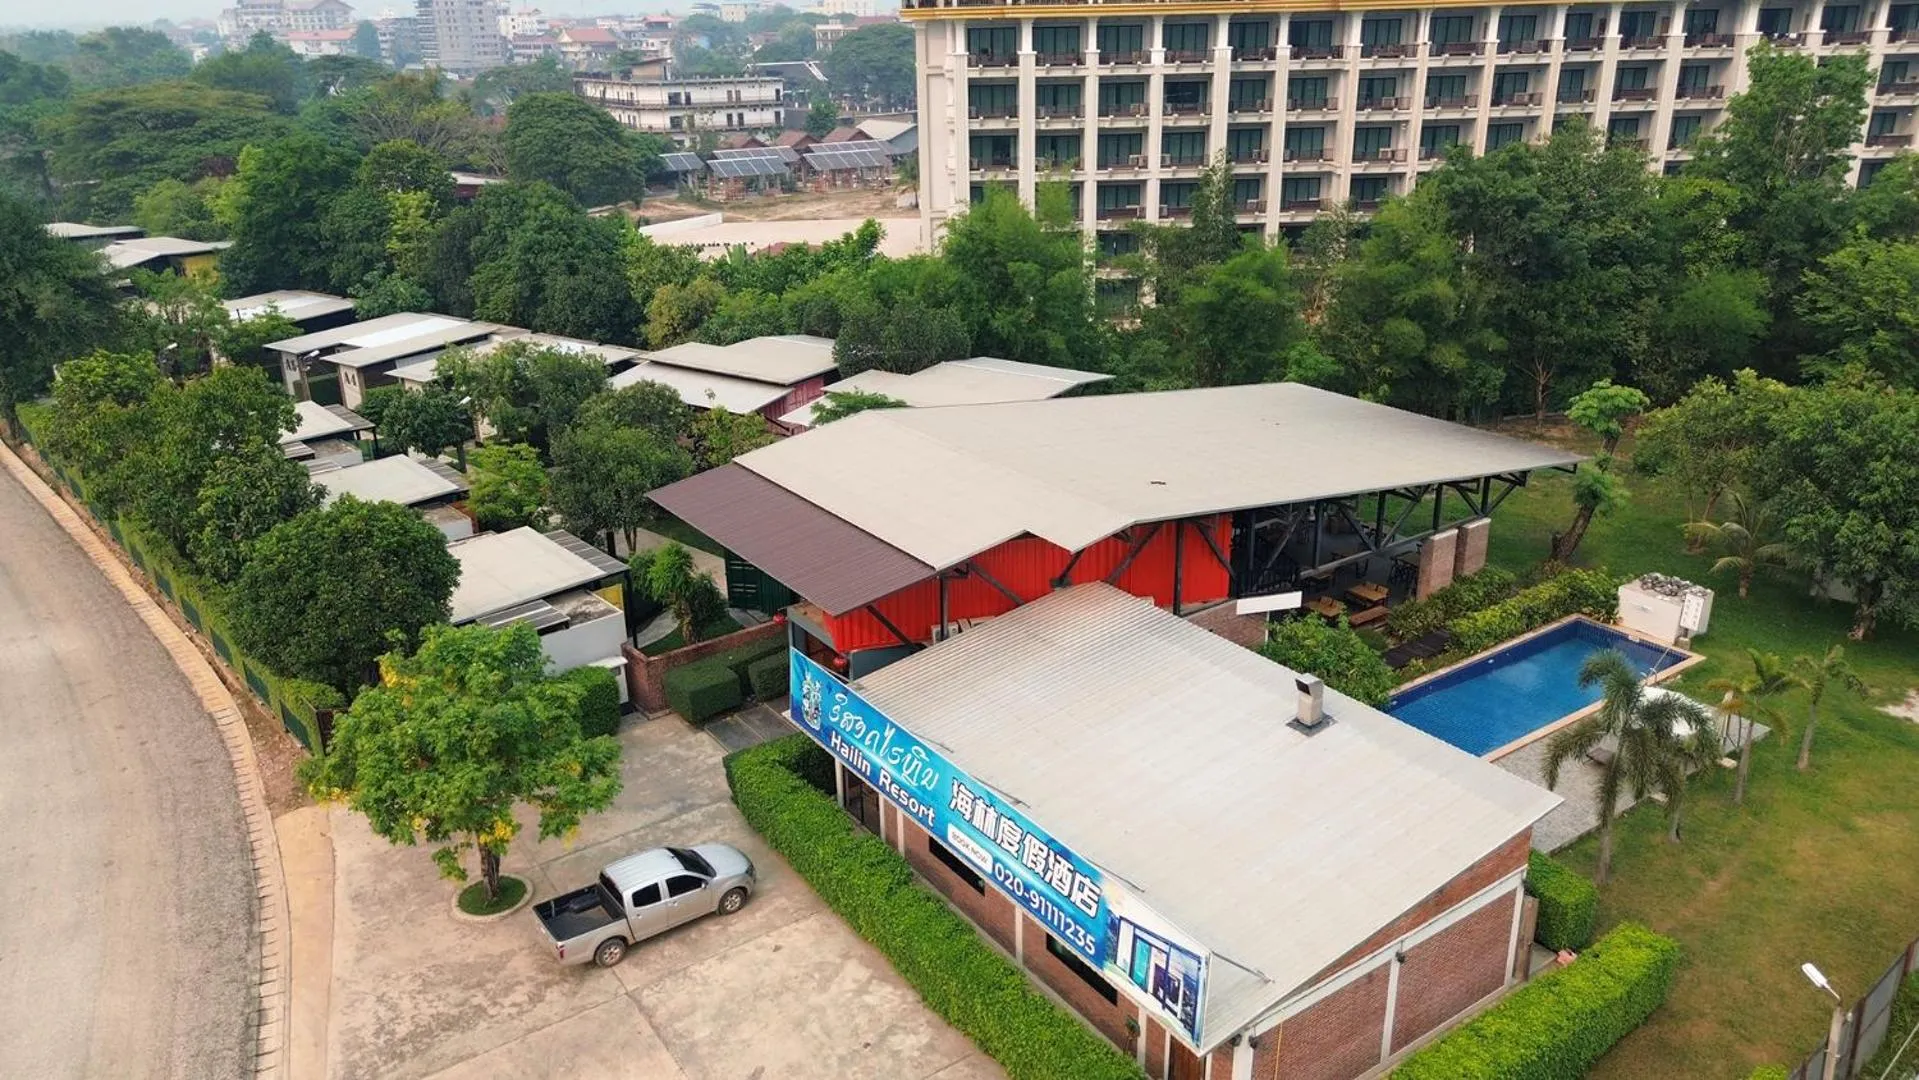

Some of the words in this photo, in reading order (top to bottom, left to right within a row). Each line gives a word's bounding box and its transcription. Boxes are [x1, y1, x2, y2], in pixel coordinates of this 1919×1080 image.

[831, 731, 871, 776] Hailin
[879, 768, 935, 827] Resort
[950, 777, 1103, 919] 海林度假酒店
[994, 862, 1096, 956] 020-91111235
